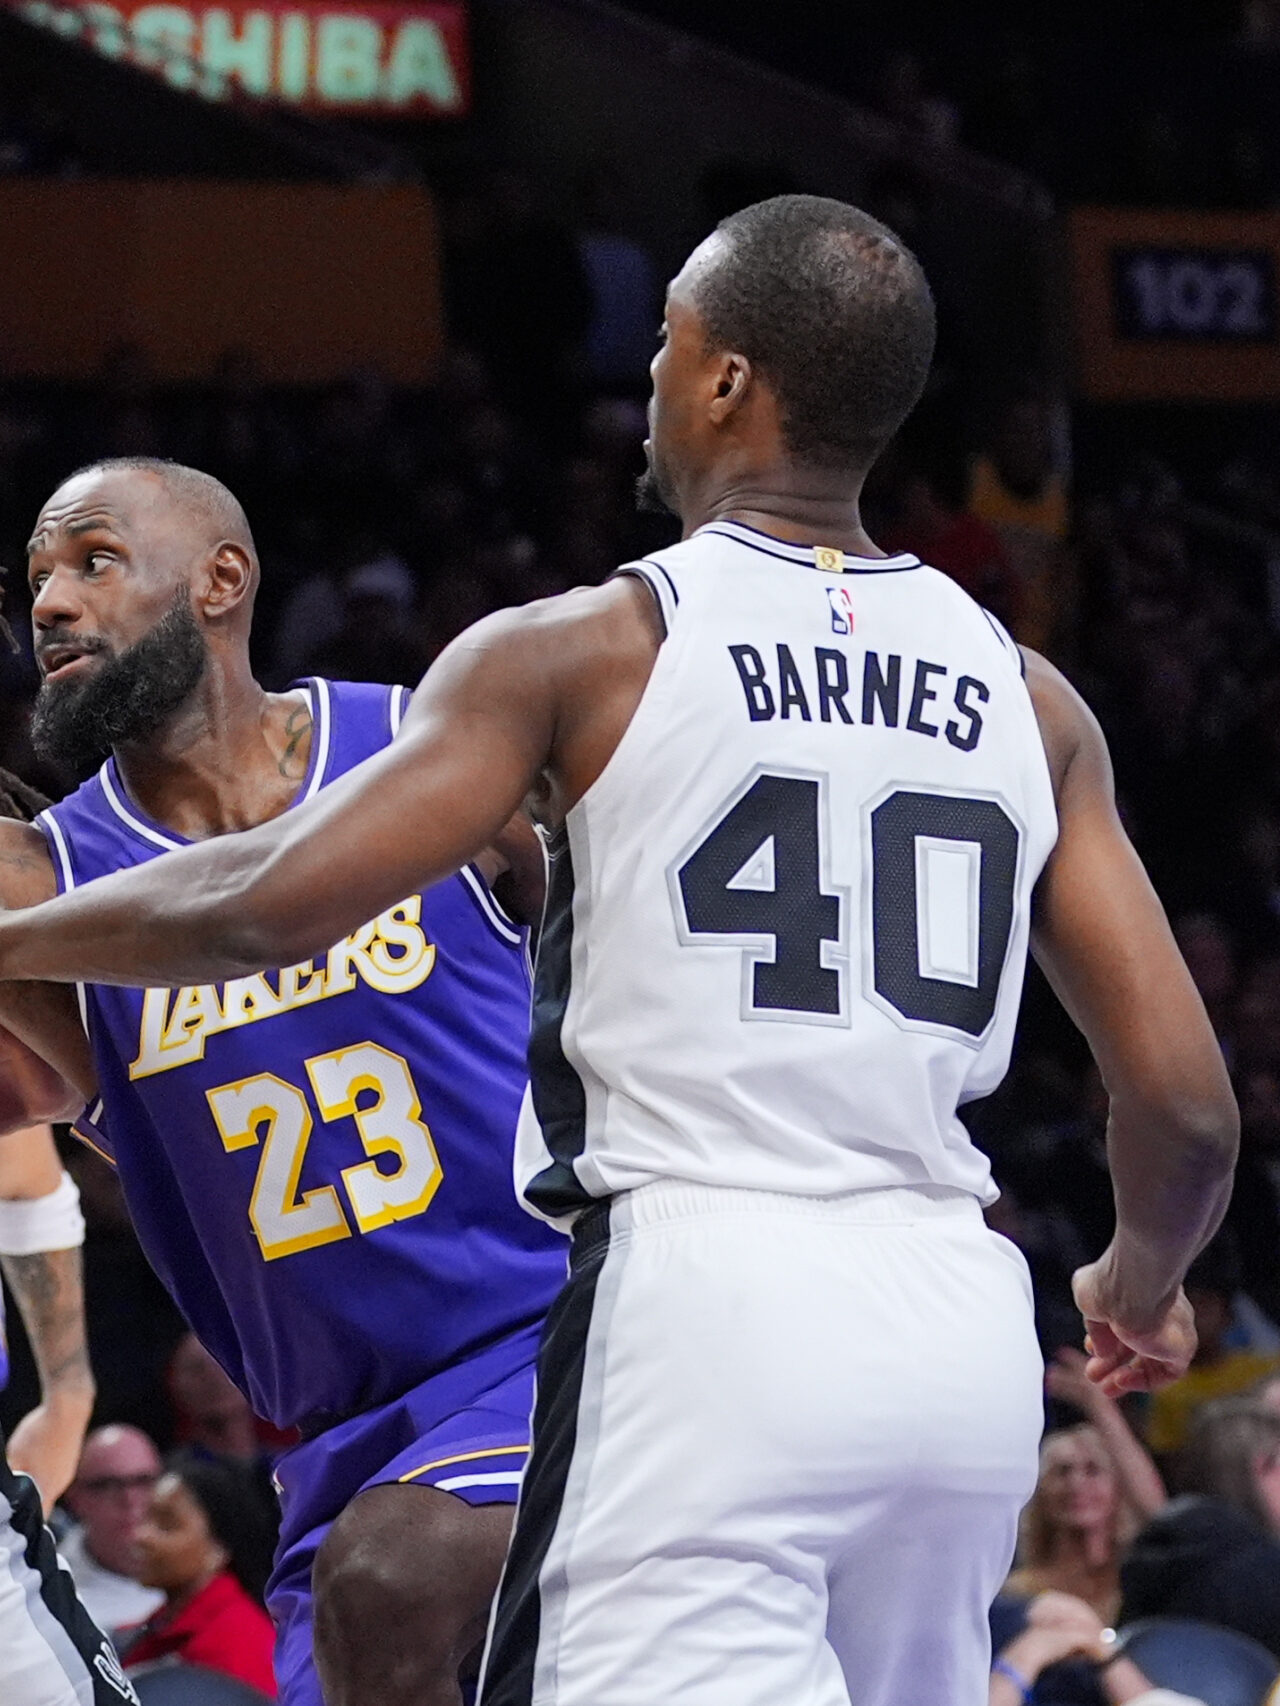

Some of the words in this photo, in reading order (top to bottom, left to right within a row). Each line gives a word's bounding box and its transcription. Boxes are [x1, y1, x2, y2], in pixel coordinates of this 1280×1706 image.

[20, 2, 461, 106] SHIBA
[1129, 260, 1264, 331] 102
[728, 643, 991, 752] BARNES
[665, 762, 1028, 1051] 40
[205, 1040, 445, 1262] 23
